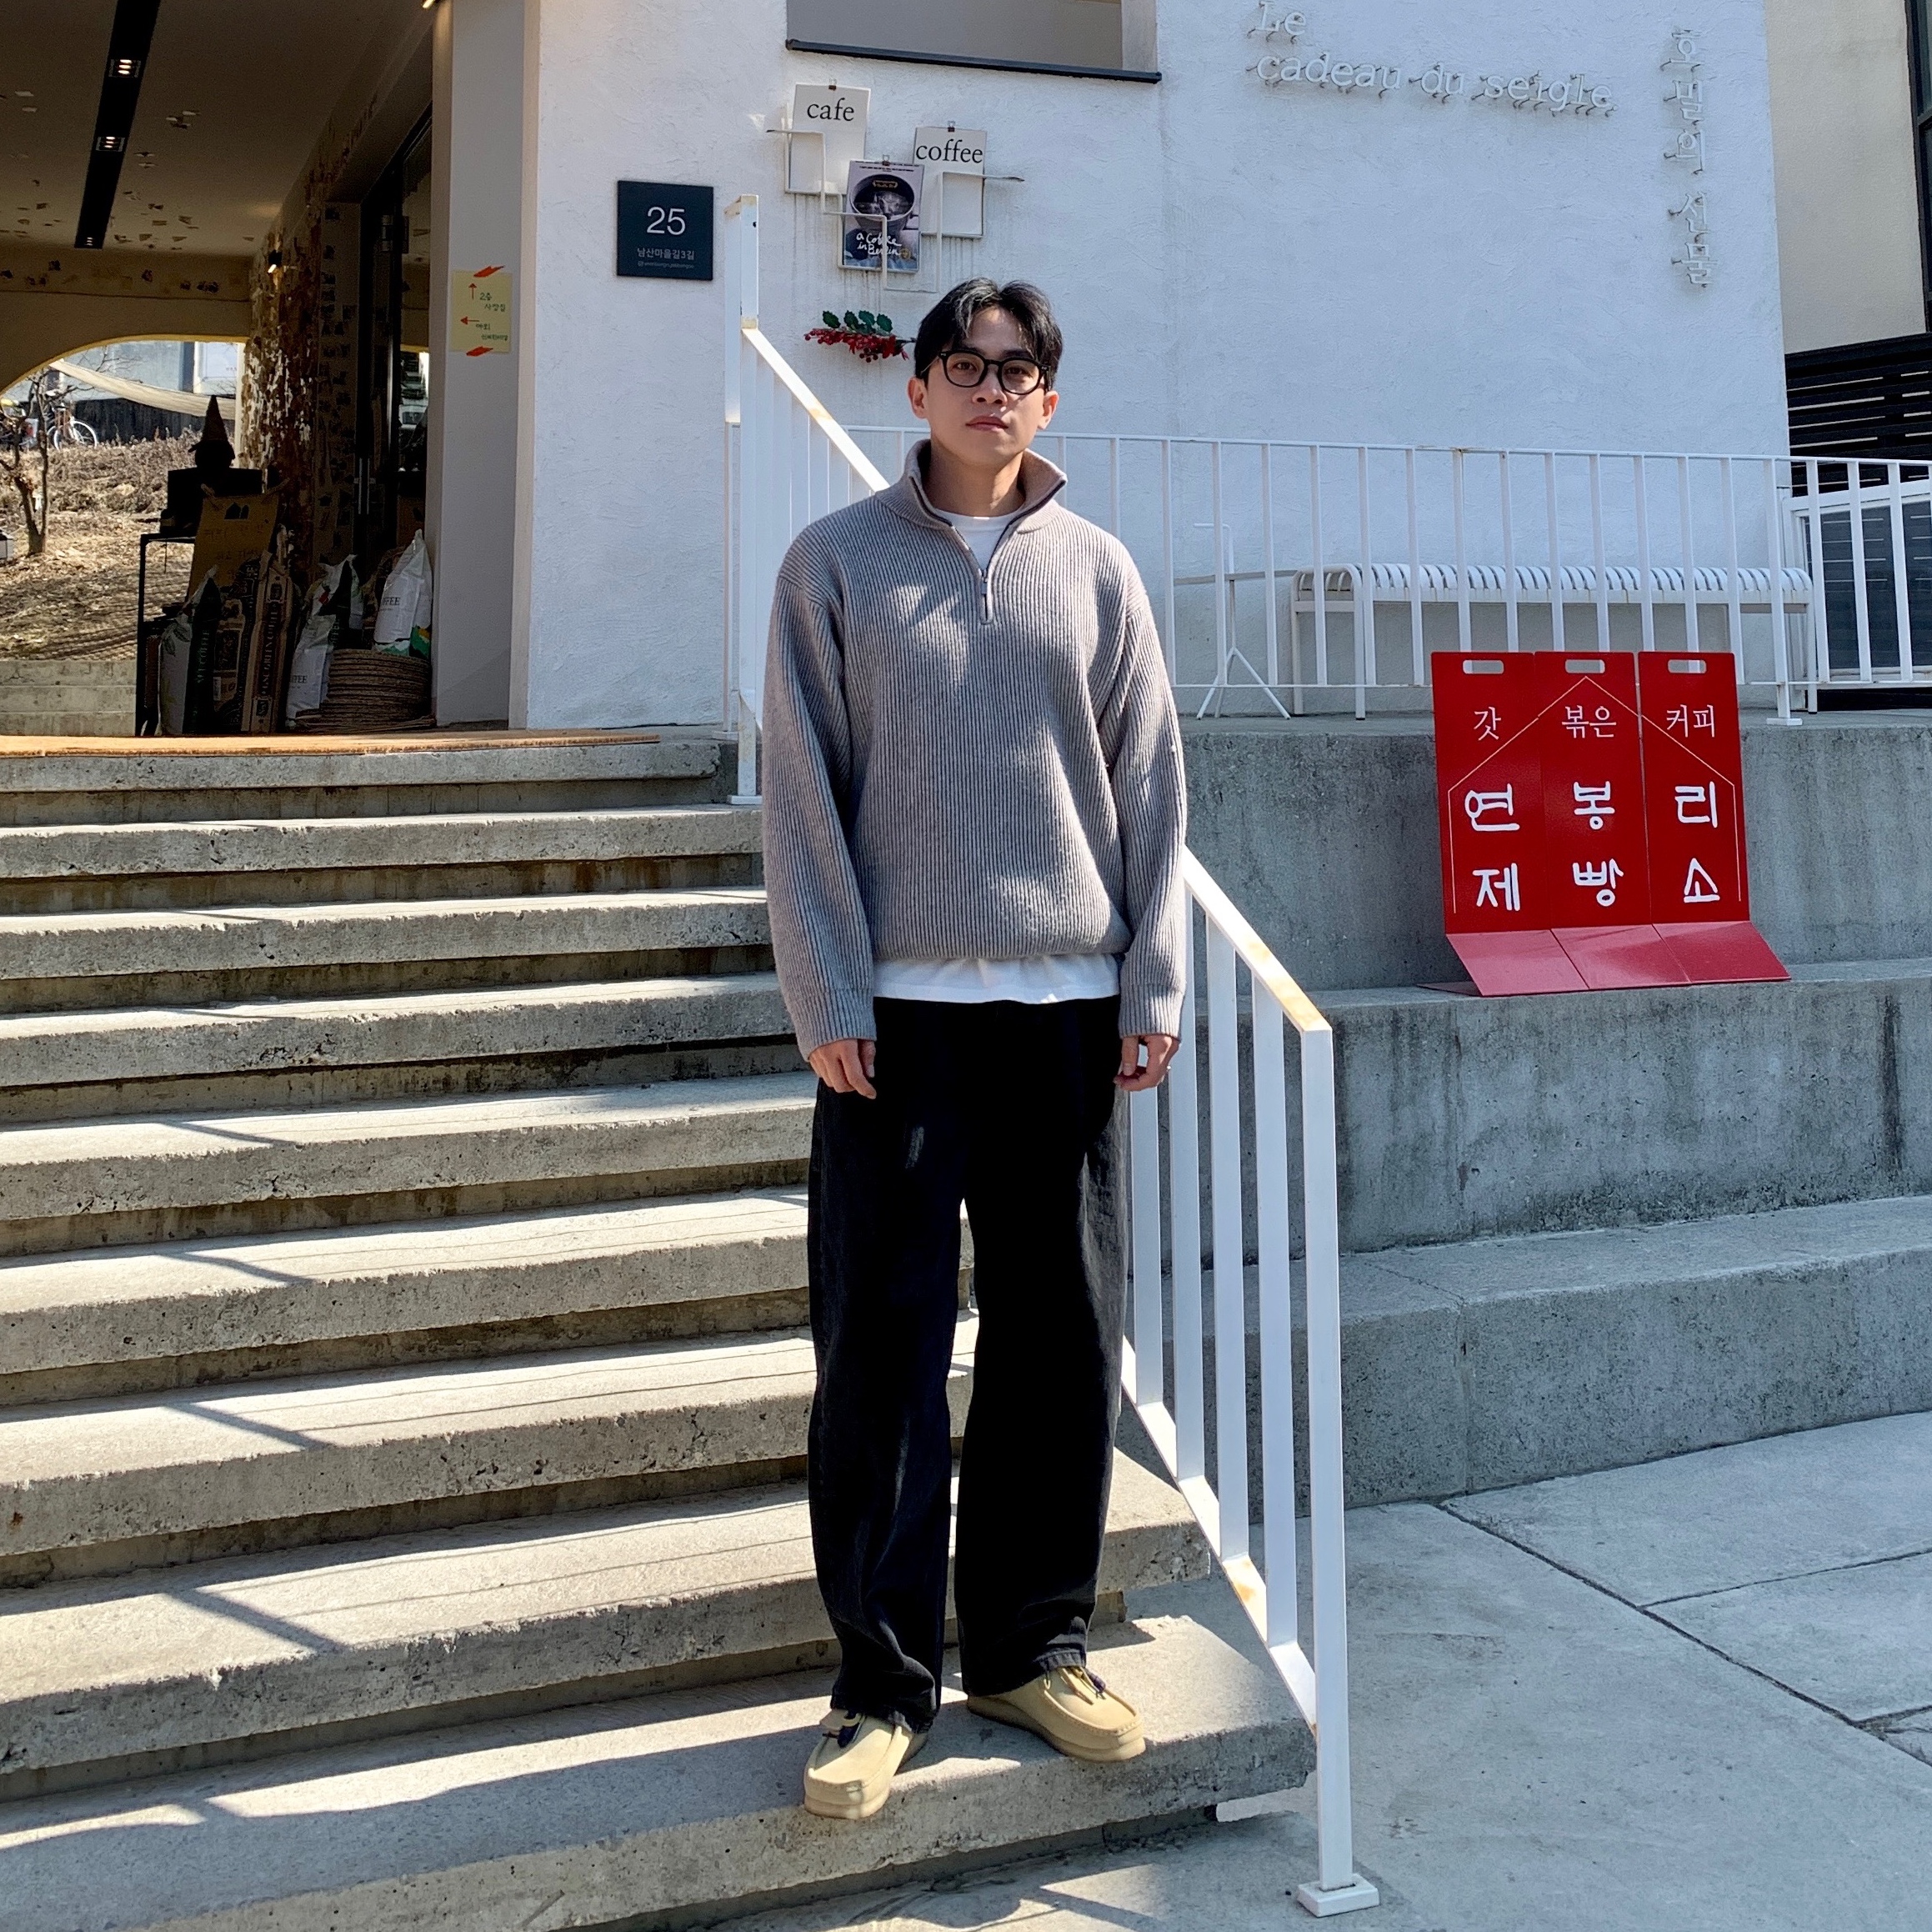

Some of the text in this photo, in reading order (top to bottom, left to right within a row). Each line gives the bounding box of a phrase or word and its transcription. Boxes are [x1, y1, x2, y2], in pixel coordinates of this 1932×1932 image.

[1254, 1, 1306, 36] Le
[1257, 52, 1613, 112] cadeau du seigle
[807, 98, 854, 121] cafe
[915, 138, 984, 163] coffee
[1668, 29, 1719, 285] 호밀의 선물
[647, 207, 686, 235] 25
[856, 233, 864, 241] a
[857, 242, 867, 250] in
[1474, 704, 1715, 740] 갓 볶은 커피
